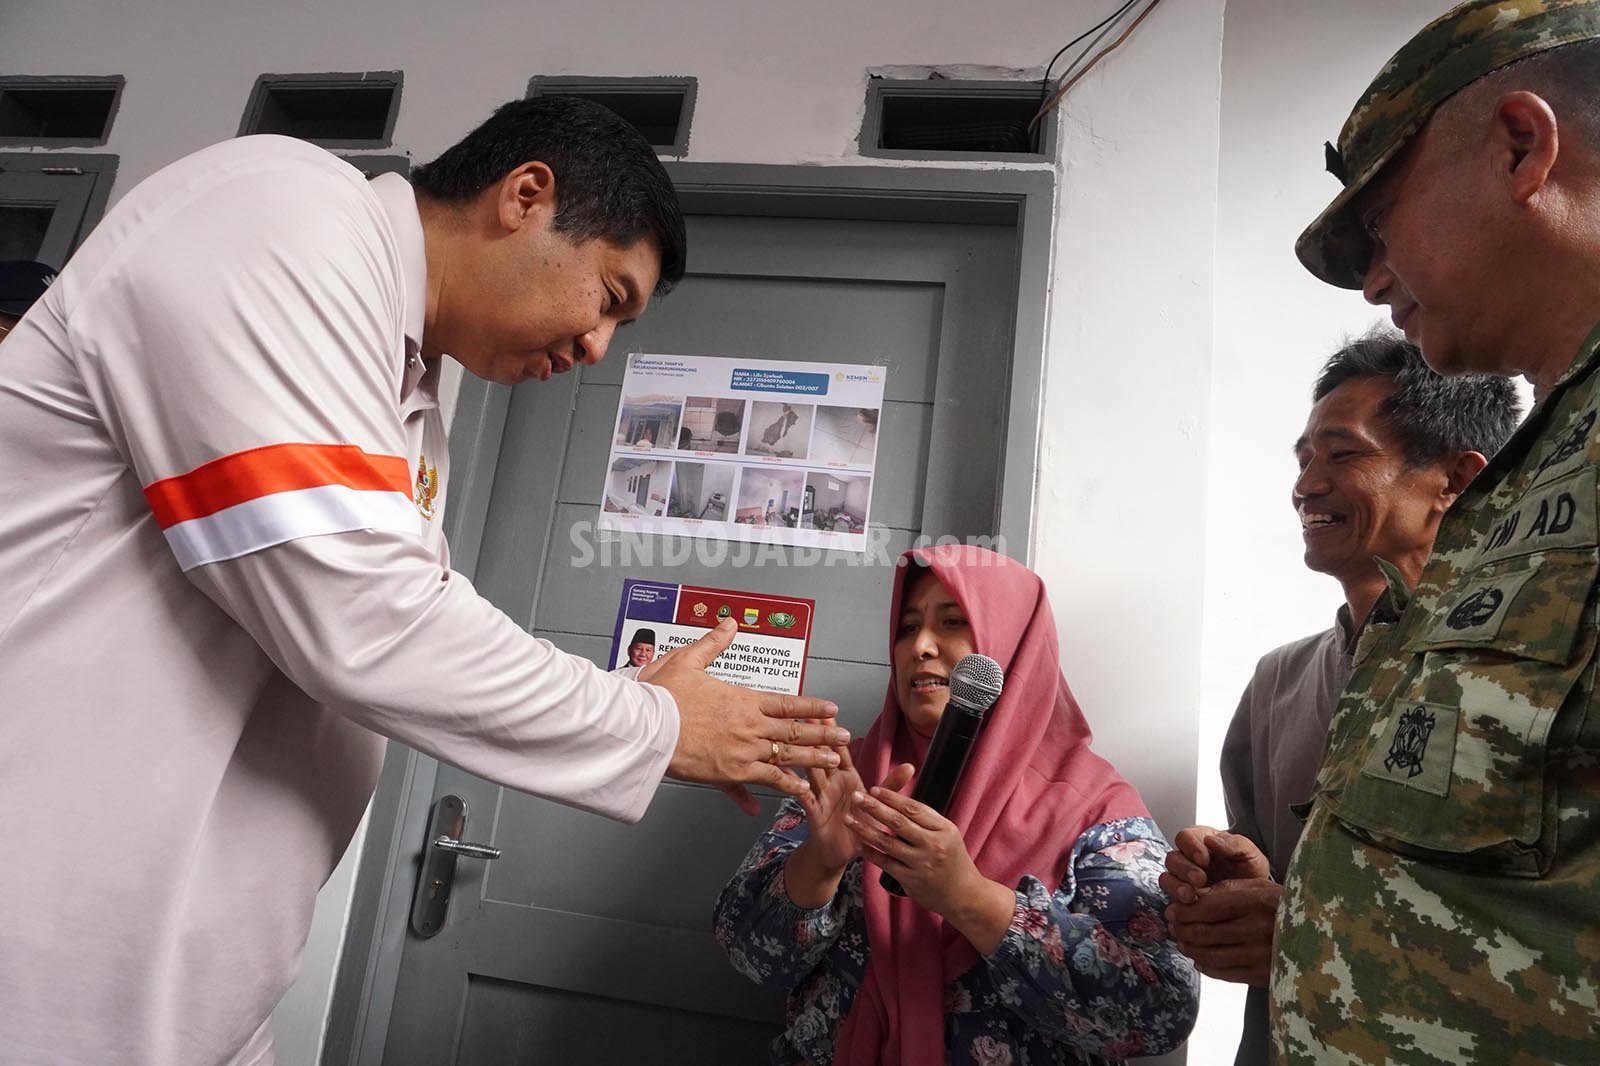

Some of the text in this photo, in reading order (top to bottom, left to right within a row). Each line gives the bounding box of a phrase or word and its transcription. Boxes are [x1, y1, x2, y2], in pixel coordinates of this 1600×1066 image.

[1521, 492, 1577, 541] AD
[752, 646, 791, 657] ROYONG
[739, 654, 770, 664] MERAH
[772, 658, 800, 668] PUTIH
[723, 661, 761, 673] BUDDHA
[763, 667, 780, 676] TZU
[782, 670, 799, 678] CHI
